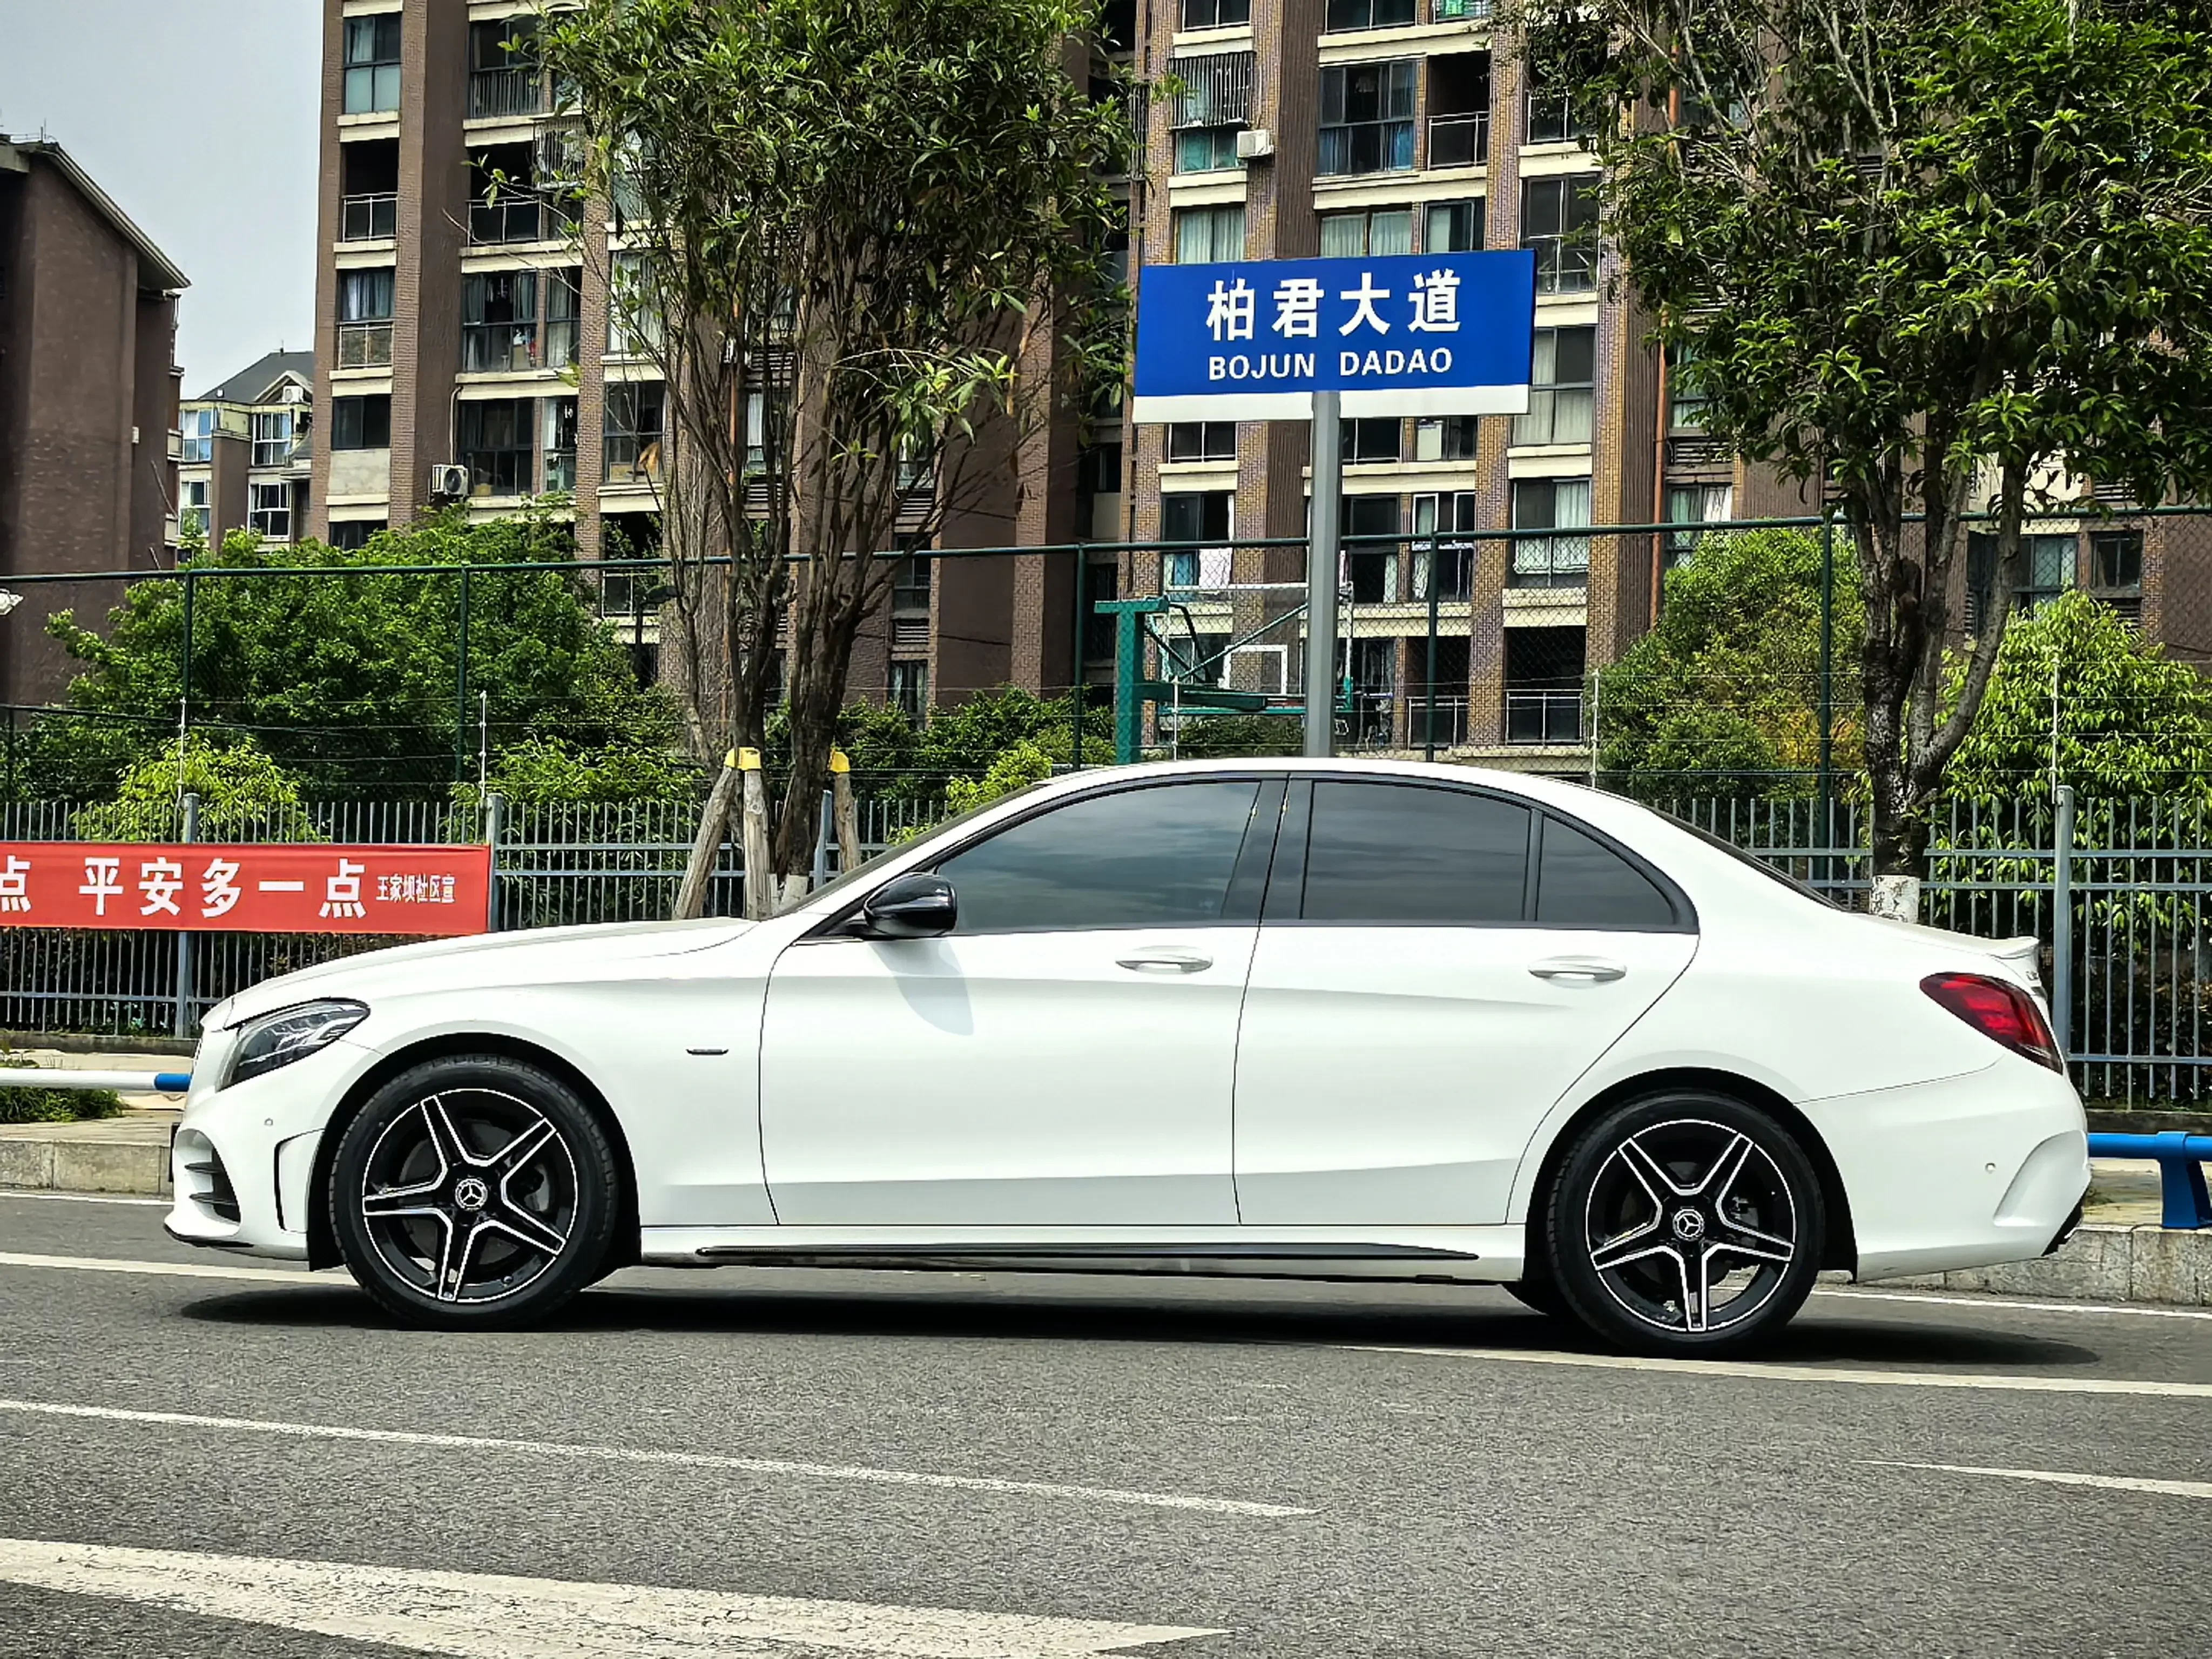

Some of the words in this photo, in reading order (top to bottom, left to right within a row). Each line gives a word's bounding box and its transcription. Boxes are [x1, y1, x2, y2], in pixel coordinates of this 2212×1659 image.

[1206, 268, 1460, 341] 柏君大道
[1209, 353, 1314, 380] BOJUN
[1340, 347, 1452, 376] DADAO
[79, 857, 367, 919] 平安多一点
[376, 873, 455, 903] 王家坝社区宣
